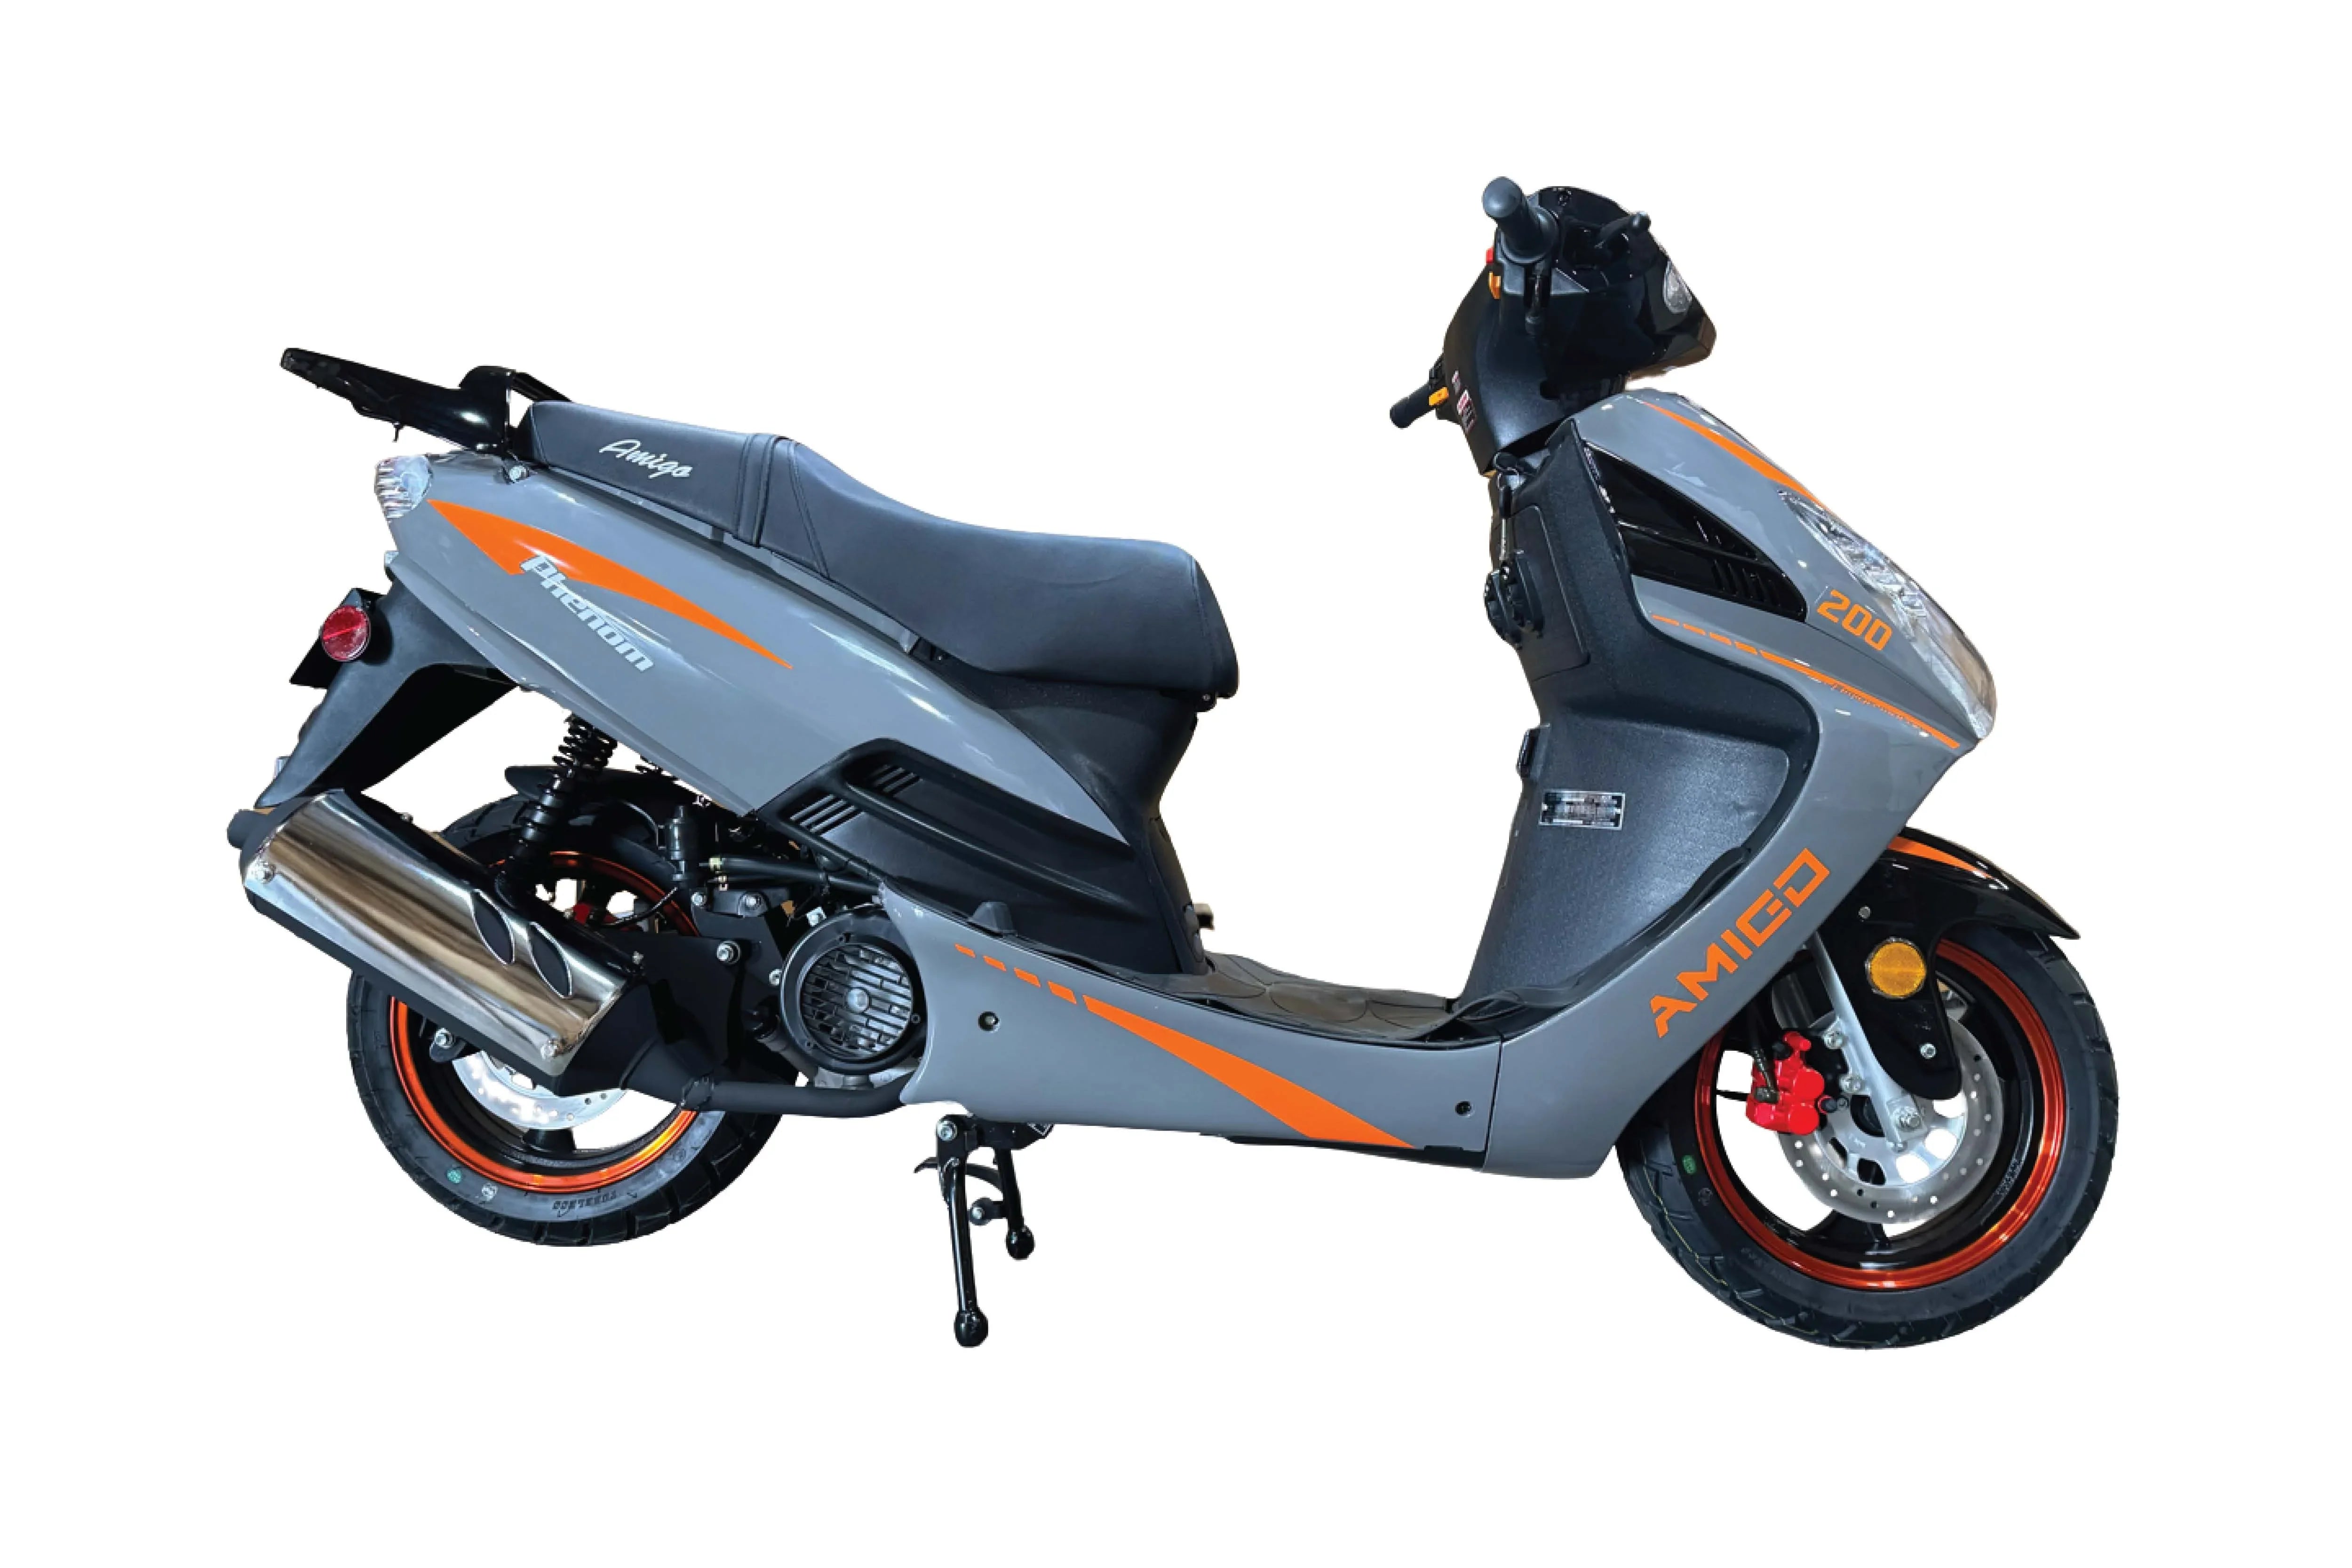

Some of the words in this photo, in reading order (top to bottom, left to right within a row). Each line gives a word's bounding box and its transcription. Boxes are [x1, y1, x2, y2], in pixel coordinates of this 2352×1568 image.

[599, 439, 693, 479] Amigo
[519, 555, 654, 672] Phenom
[1817, 590, 1892, 651] 200
[1650, 847, 1830, 1038] AMIGO
